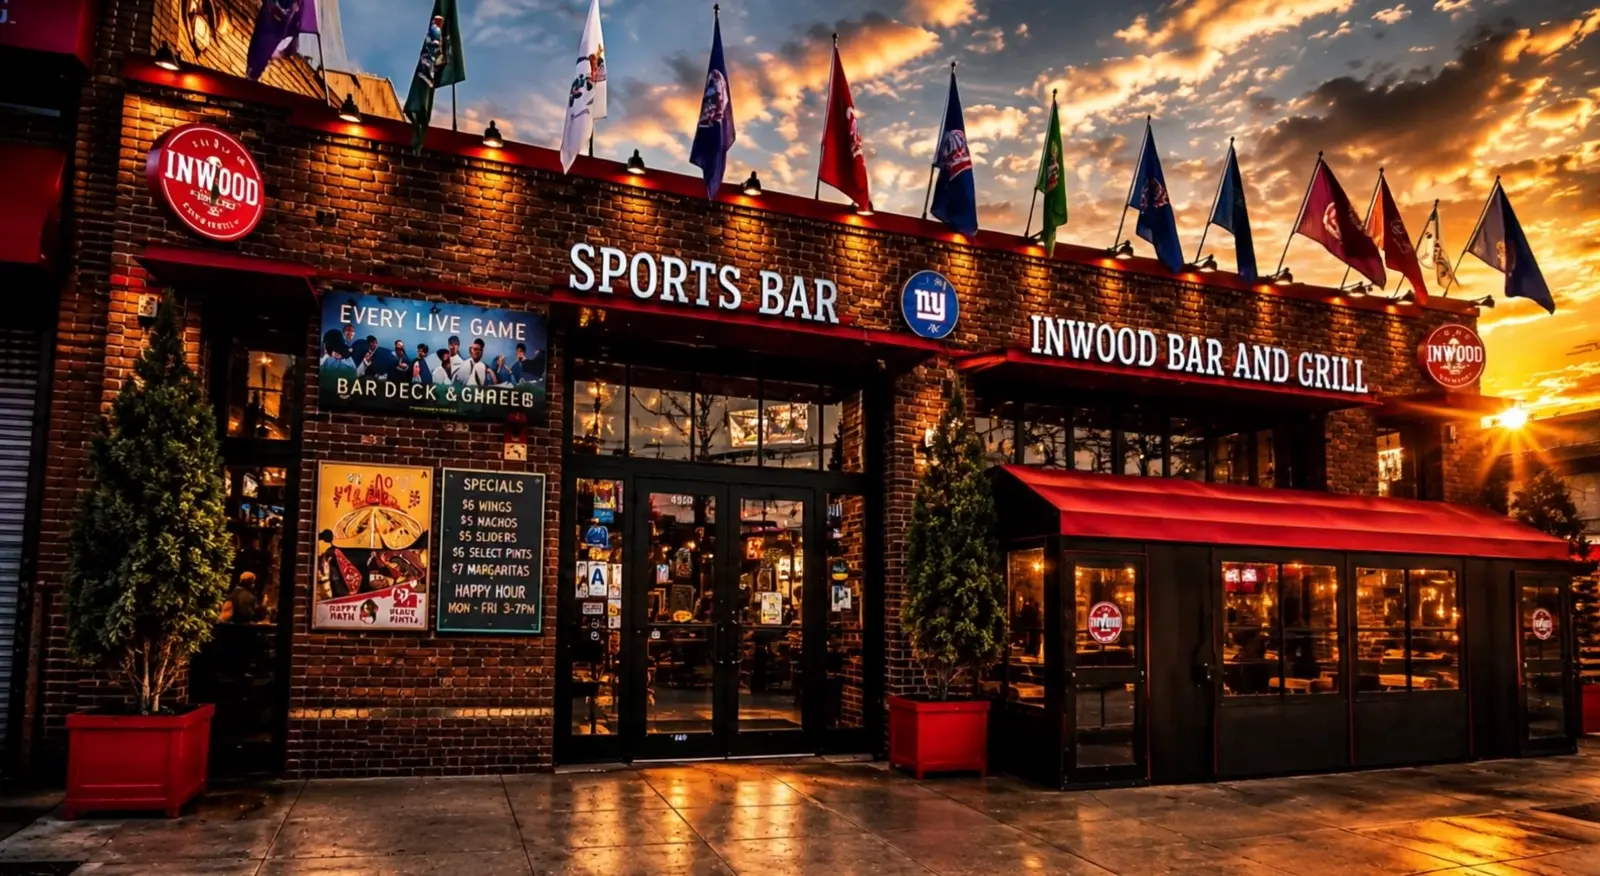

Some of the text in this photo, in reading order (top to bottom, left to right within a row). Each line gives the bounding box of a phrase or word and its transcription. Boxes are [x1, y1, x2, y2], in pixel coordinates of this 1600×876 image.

[165, 149, 258, 206] INWOOD
[569, 242, 839, 324] SPORTS BAR
[340, 304, 526, 341] EVERY LIVE GAME
[1030, 314, 1369, 393] INWOOD BAR AND GRILL
[1427, 344, 1483, 363] INWOOD
[337, 378, 377, 396] BAR
[384, 381, 437, 401] DECK
[446, 388, 457, 402] &
[463, 478, 524, 493] SPECIALS
[462, 499, 512, 513] $6 WINGS
[460, 514, 518, 528] $5 NACHOS
[459, 530, 517, 543] $5 SLIDERS
[452, 547, 533, 560] $6 SELECT PINTS
[452, 563, 530, 577] $7 MARGARITAS
[591, 567, 604, 585] A
[455, 584, 526, 599] HAPPY HOUR
[448, 602, 471, 614] MON
[481, 602, 497, 614] FRI
[503, 603, 535, 615] 3-7PM
